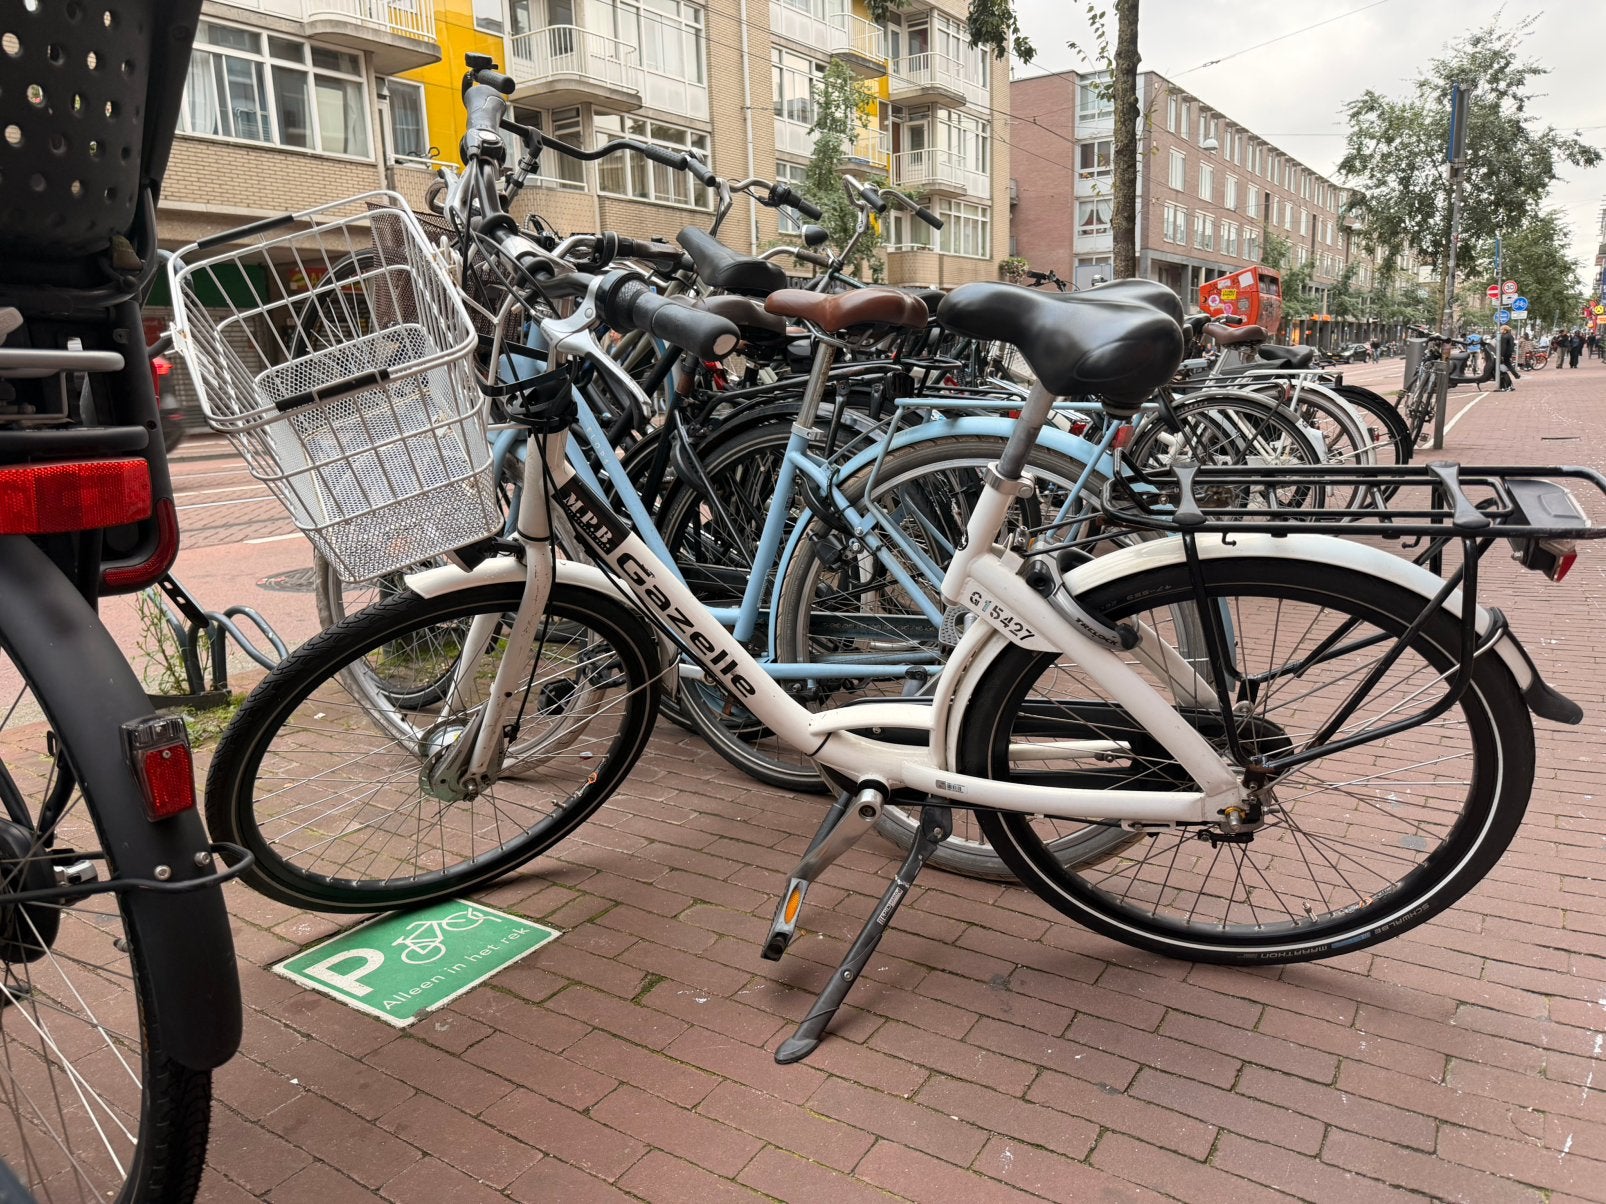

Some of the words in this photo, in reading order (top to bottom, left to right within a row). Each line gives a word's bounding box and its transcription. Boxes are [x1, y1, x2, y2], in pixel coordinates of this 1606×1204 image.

[616, 552, 756, 698] Gazelle
[1374, 902, 1430, 935] SCHWALBE
[302, 948, 385, 997] P
[383, 973, 445, 1010] Alleen
[447, 961, 467, 975] in
[465, 943, 500, 963] het
[501, 927, 530, 945] rek
